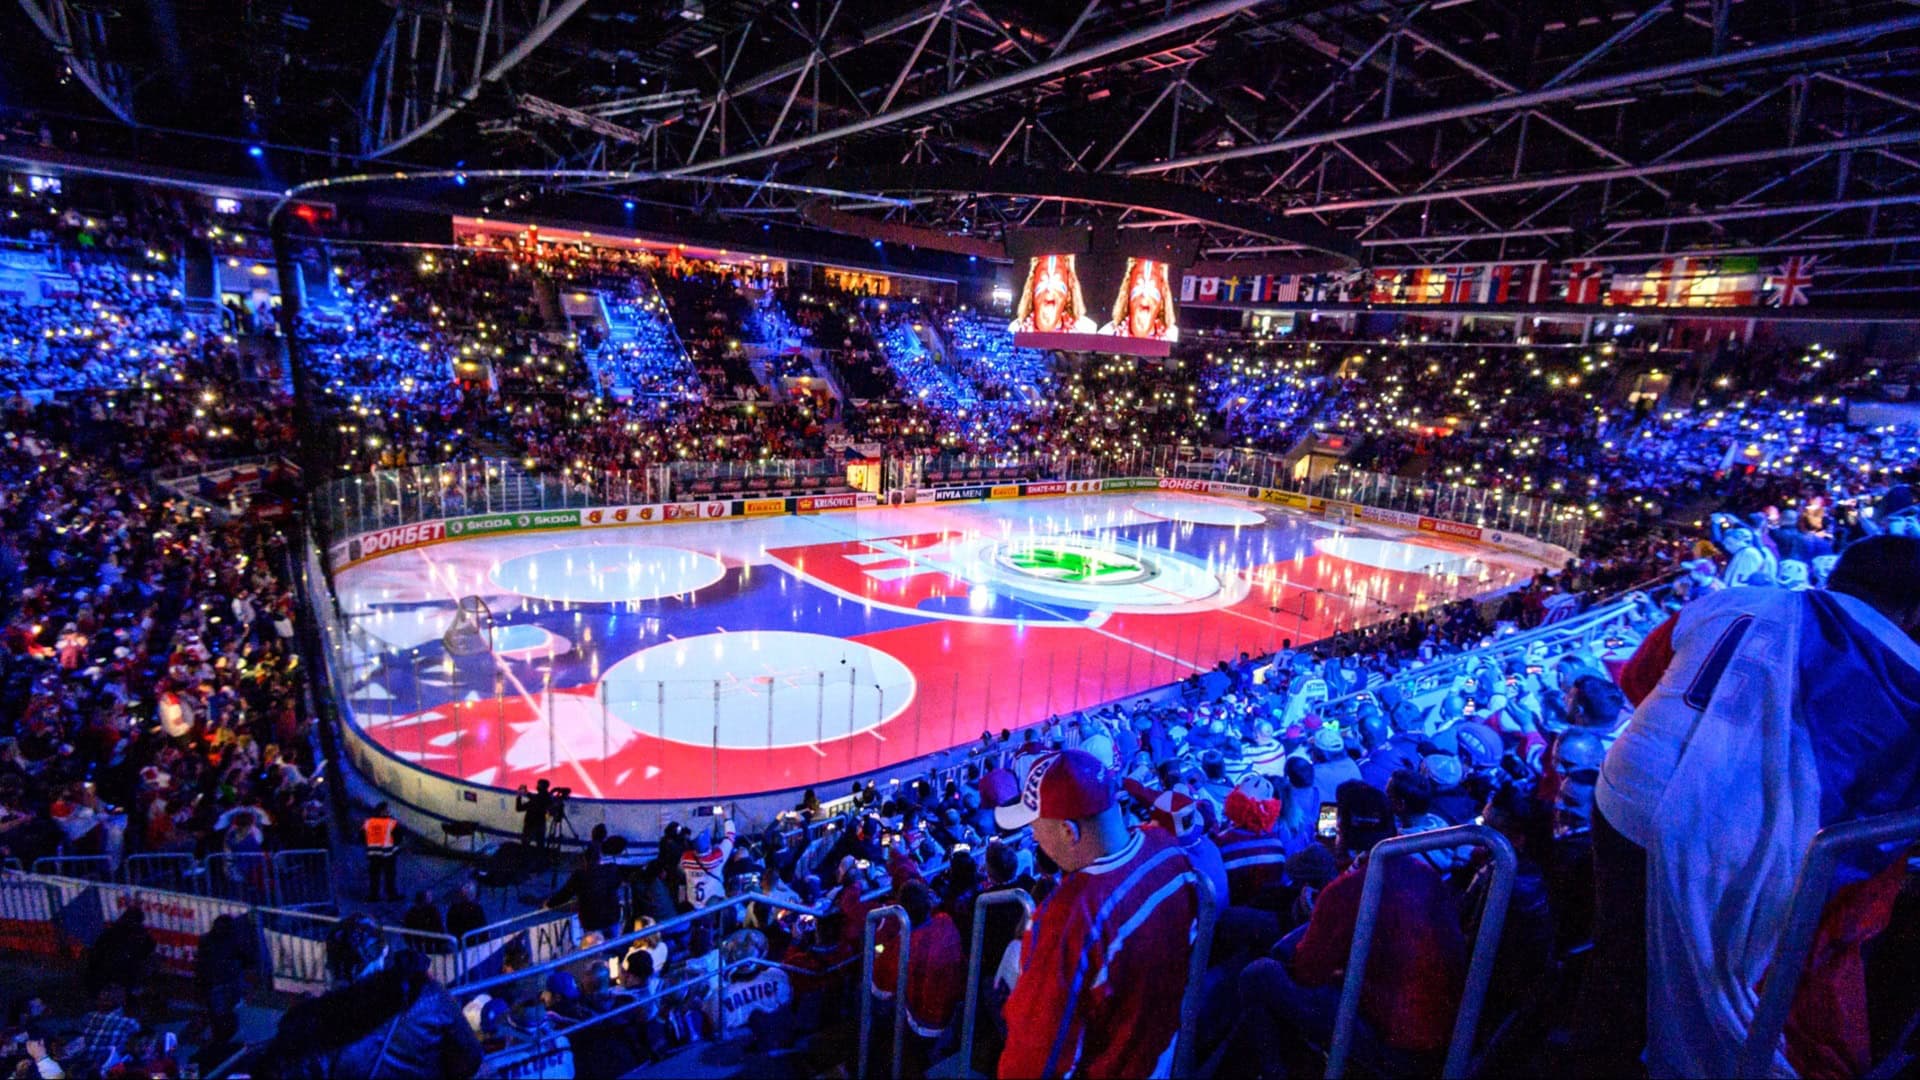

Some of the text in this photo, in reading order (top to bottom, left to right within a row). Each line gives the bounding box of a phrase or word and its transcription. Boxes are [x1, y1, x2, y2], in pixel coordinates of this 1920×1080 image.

[1160, 479, 1209, 491] ФОНБЕТ
[936, 490, 961, 499] NIVEA
[962, 489, 982, 497] MEN
[467, 514, 577, 531] ŠKODA ŠKODA
[363, 523, 445, 556] ФОНБЕТ
[695, 881, 705, 902] 6
